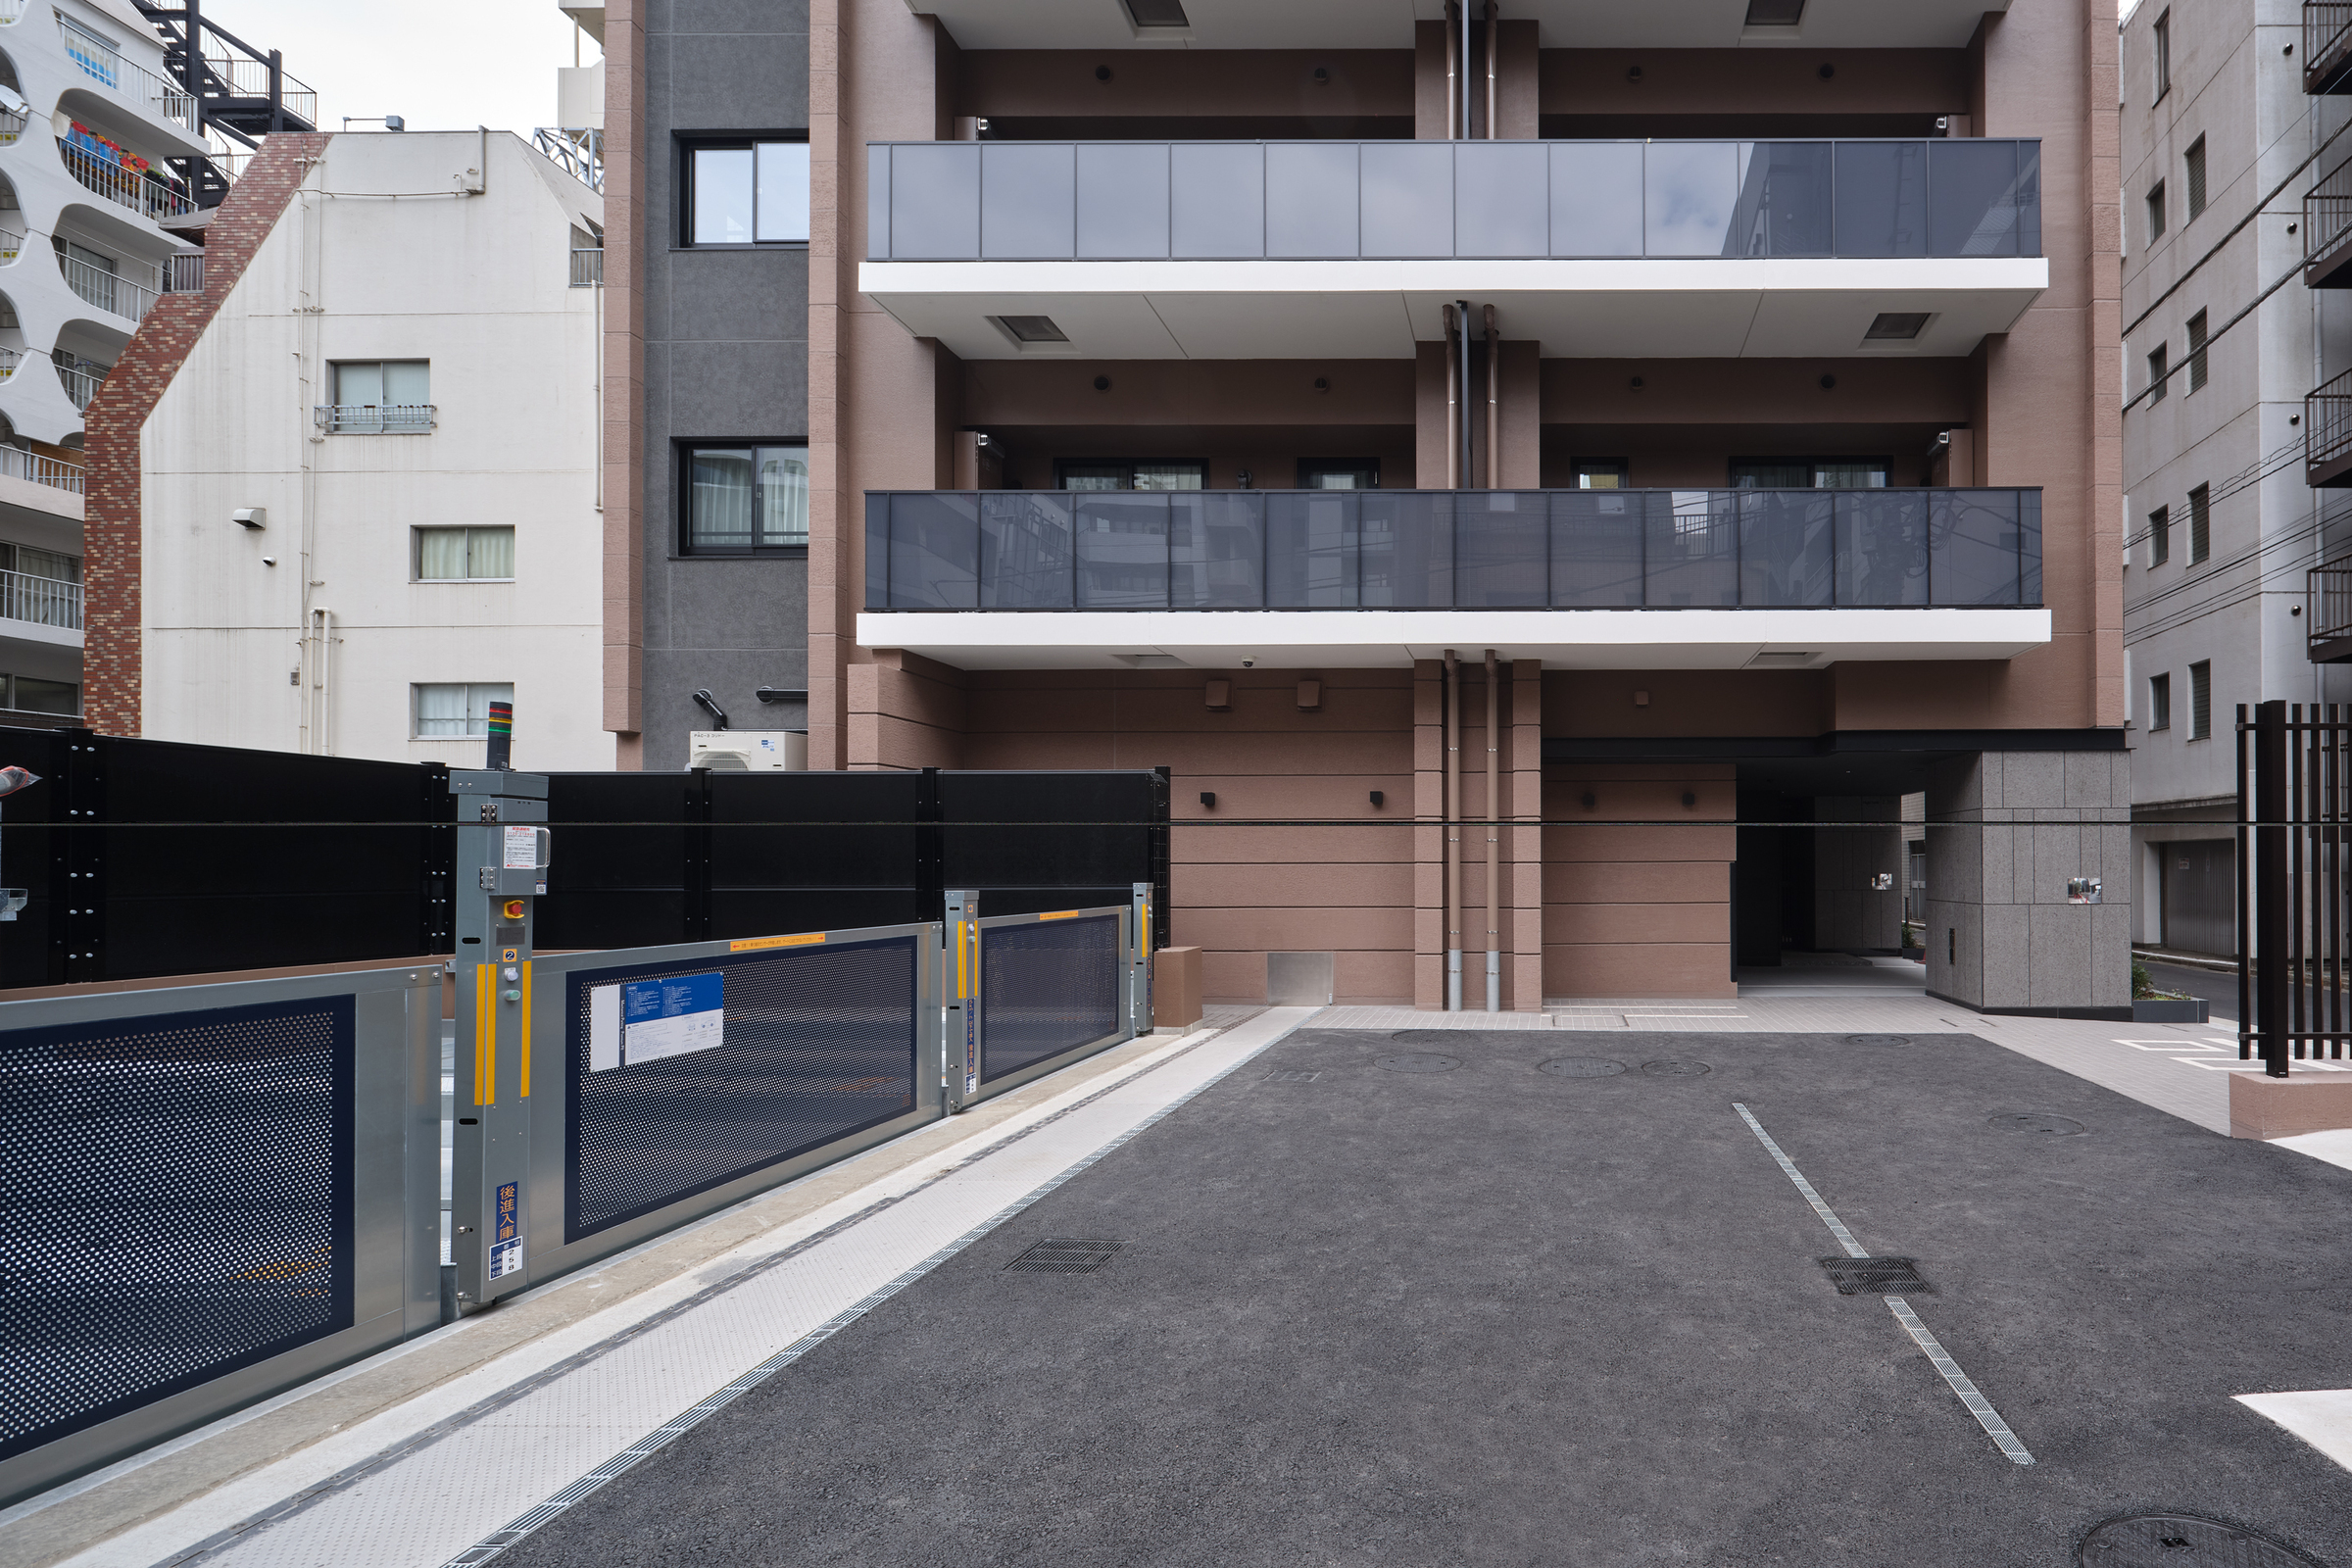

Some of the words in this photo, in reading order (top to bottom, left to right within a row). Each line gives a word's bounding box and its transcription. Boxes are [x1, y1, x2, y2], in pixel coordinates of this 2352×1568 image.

[500, 1185, 515, 1242] 後進入庫
[491, 1253, 503, 1262] 上段
